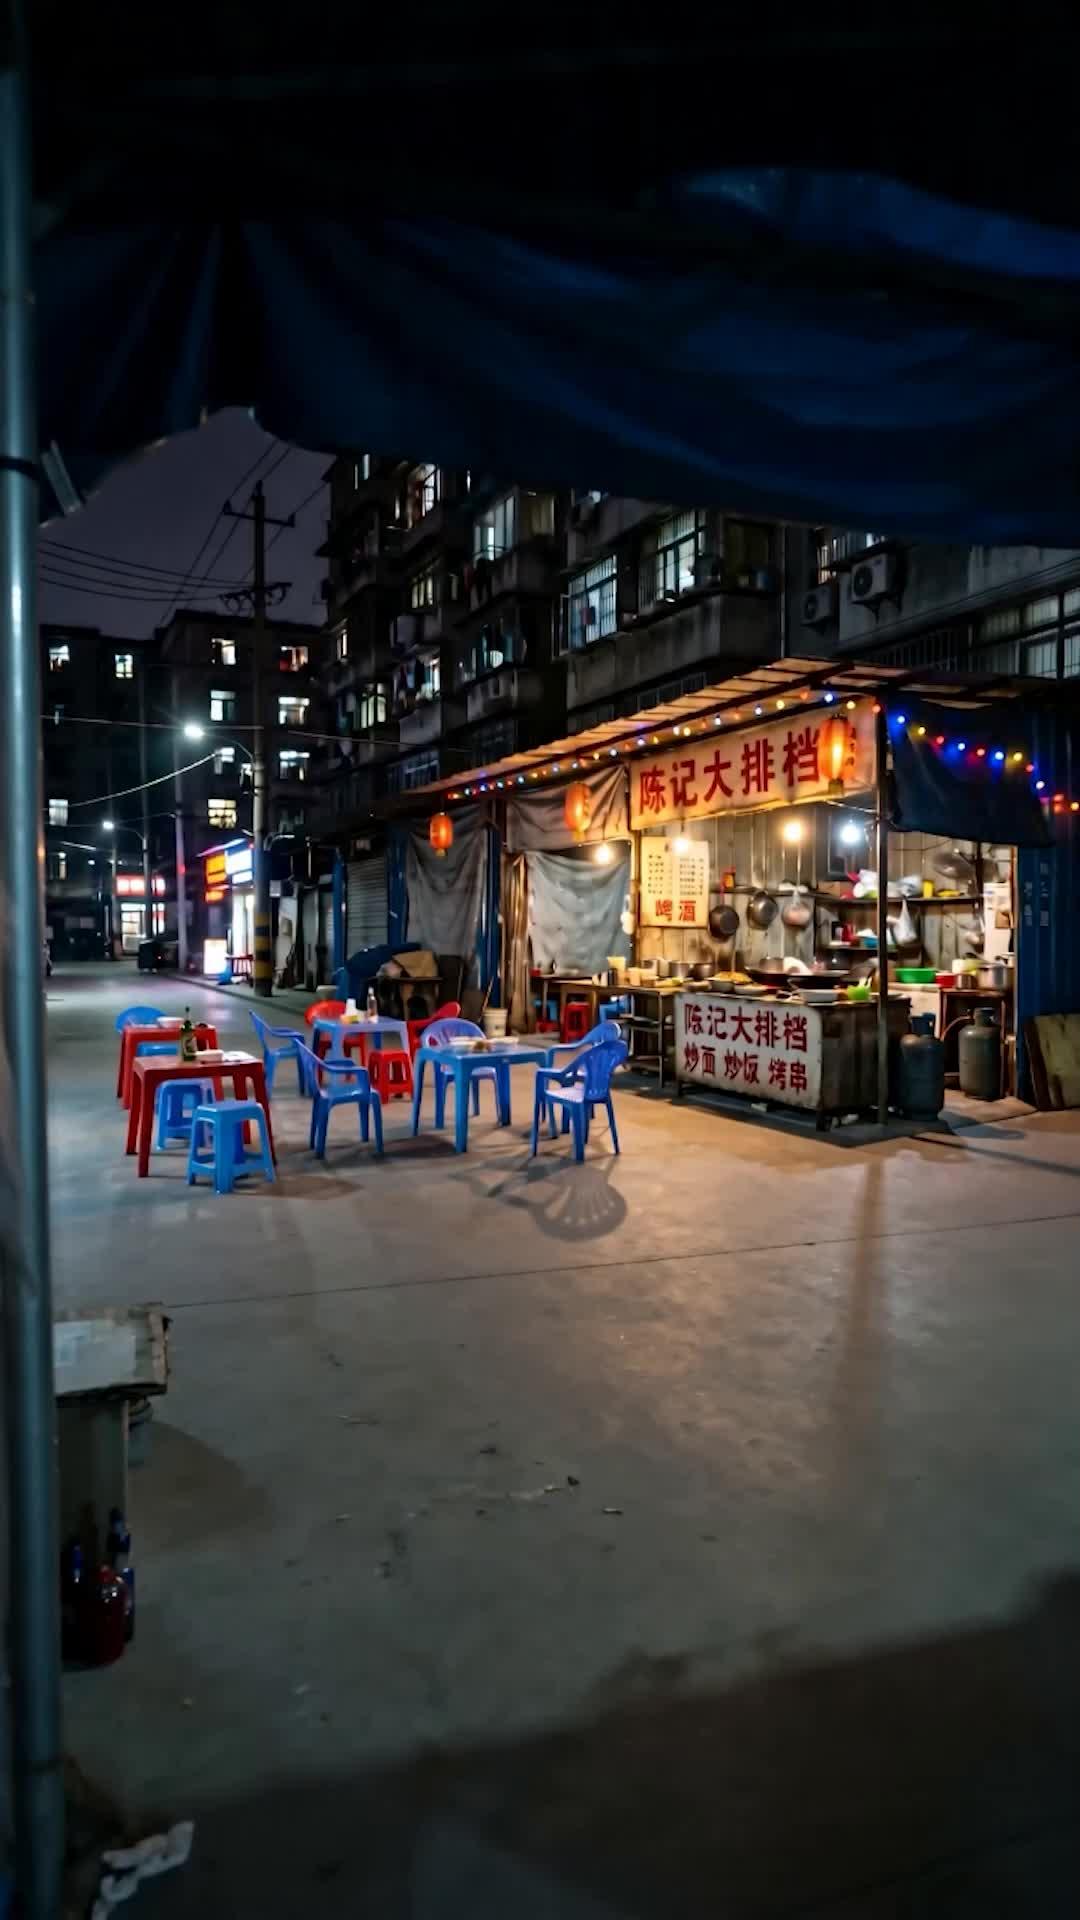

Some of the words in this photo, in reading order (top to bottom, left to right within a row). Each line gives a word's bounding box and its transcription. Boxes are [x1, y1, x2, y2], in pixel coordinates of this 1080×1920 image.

[639, 726, 819, 815] 陈记大排档
[684, 1003, 808, 1053] 陈记大排档
[684, 1042, 716, 1077] 炒面
[724, 1049, 760, 1084] 炒饭
[768, 1057, 808, 1094] 烤串
